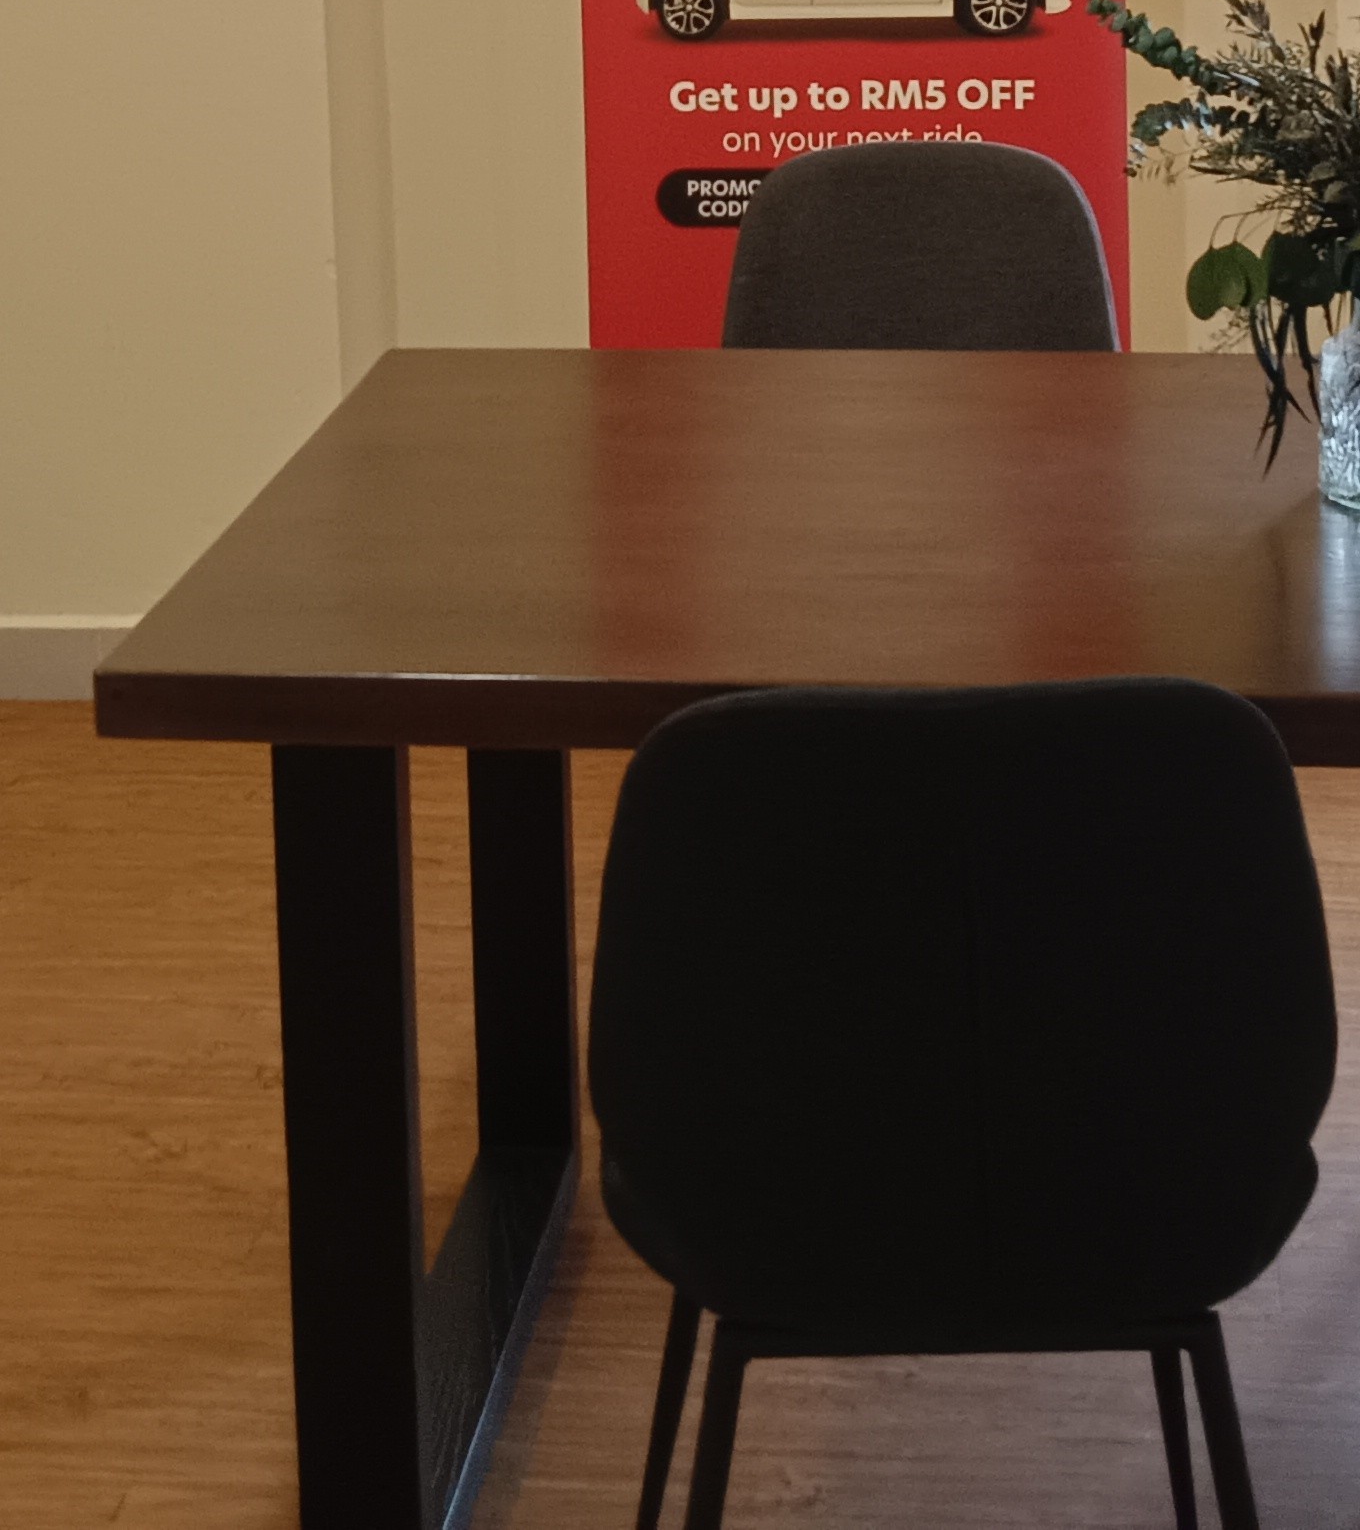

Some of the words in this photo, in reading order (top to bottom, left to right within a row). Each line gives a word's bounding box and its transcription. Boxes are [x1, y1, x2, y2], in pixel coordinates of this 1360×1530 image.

[669, 81, 739, 112] Get
[748, 86, 798, 118] up
[807, 82, 850, 111] to
[861, 79, 946, 110] RM5
[957, 79, 1035, 110] OFF
[722, 132, 761, 152] on
[769, 131, 838, 158] your
[846, 128, 914, 146] next
